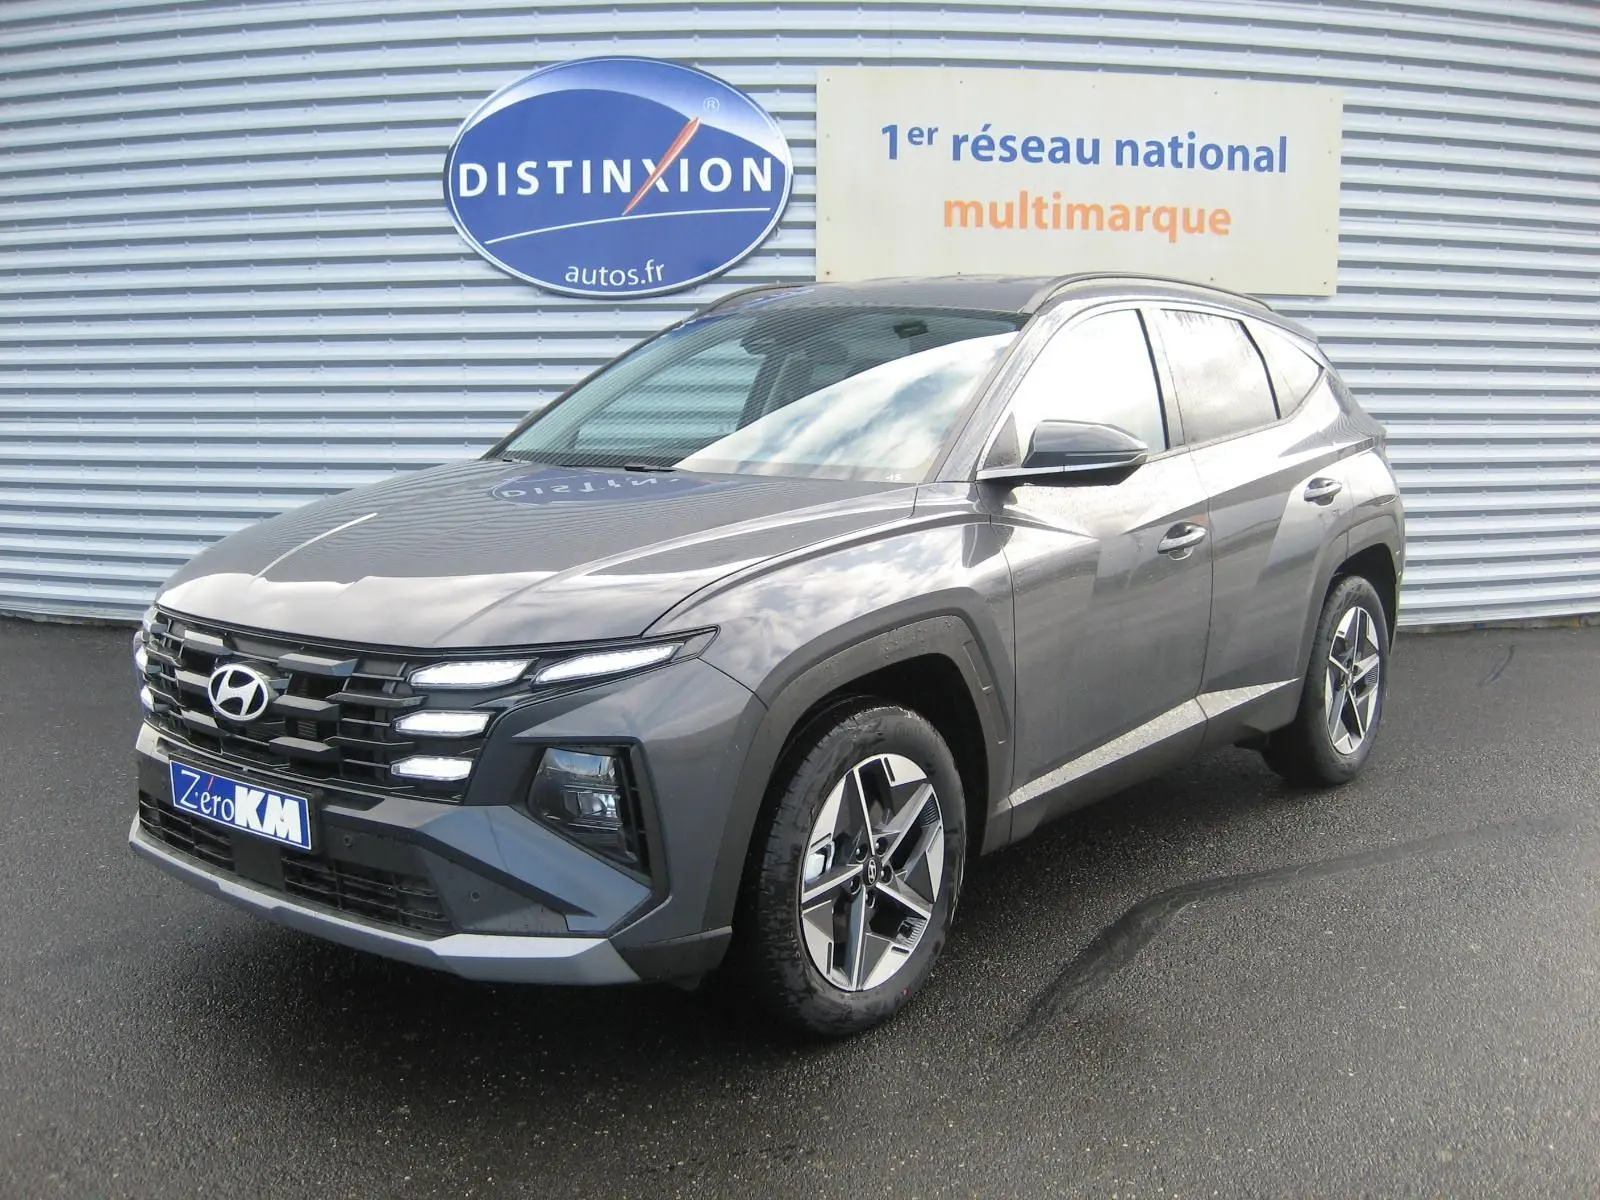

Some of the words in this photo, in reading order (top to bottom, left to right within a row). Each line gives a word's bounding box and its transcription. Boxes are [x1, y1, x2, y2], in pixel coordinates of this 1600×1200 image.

[881, 124, 939, 160] 1er
[951, 123, 1100, 165] réseau
[1114, 131, 1288, 173] national
[458, 156, 773, 198] DISTINXION
[943, 190, 1232, 243] multimarque
[564, 259, 666, 287] autos.fr
